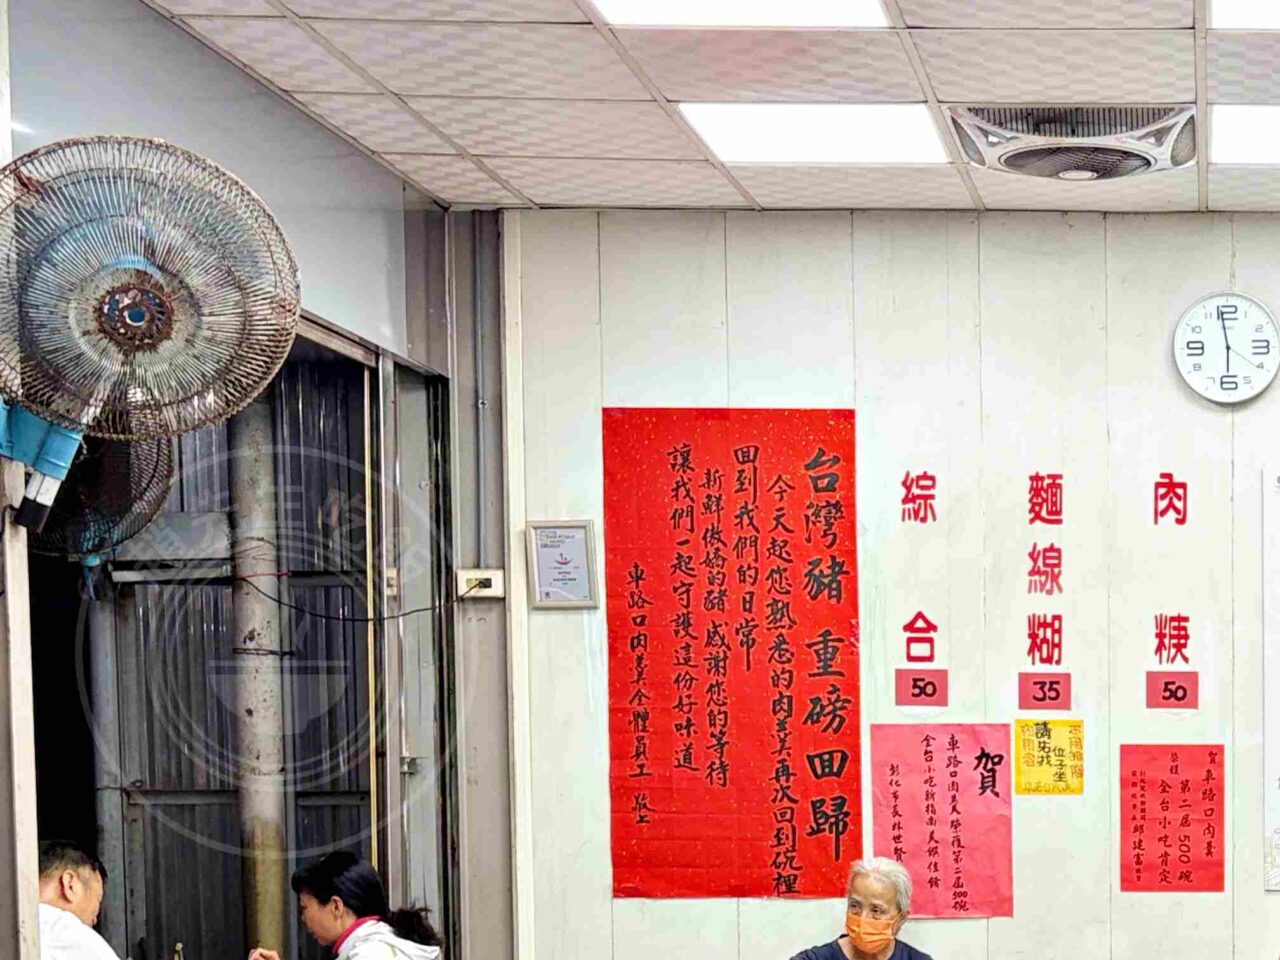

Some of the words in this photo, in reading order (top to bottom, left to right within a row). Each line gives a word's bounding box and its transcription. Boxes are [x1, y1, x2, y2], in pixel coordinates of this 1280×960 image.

[1217, 305, 1238, 320] 12
[1186, 340, 1205, 357] 9
[1251, 339, 1270, 355] 3
[1220, 375, 1238, 390] 6
[804, 448, 850, 603] 台灣豬
[1027, 472, 1063, 666] 麵線糊
[667, 443, 699, 772] 讓我們一起守護這份好味道
[911, 678, 937, 697] 50
[1033, 681, 1060, 702] 35
[1162, 681, 1188, 702] 50
[973, 747, 1004, 797] 賀
